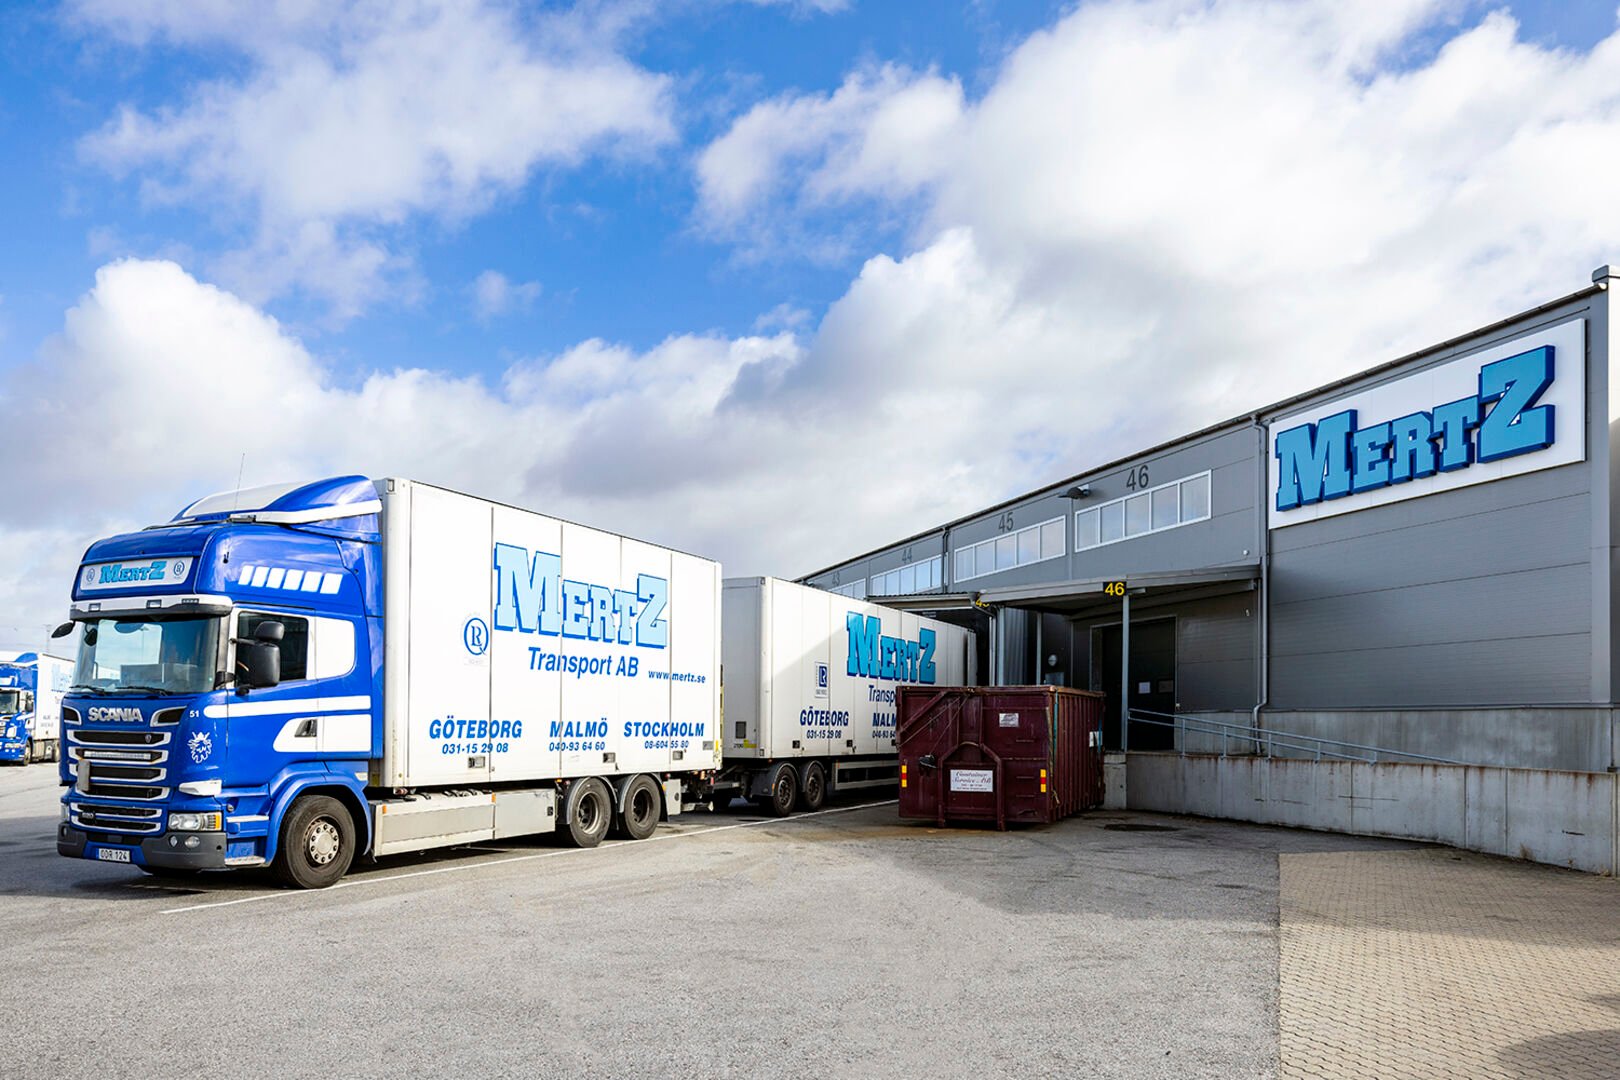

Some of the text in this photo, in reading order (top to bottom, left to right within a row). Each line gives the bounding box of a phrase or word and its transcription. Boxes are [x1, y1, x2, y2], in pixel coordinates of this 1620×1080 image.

[1125, 465, 1149, 491] 46
[997, 512, 1014, 532] 45
[902, 547, 913, 564] 44
[1104, 582, 1125, 596] 46
[528, 646, 639, 679] Transport AB
[648, 669, 706, 684] www.mertz.se
[868, 685, 896, 707] Transp
[87, 706, 144, 722] SCANIA
[189, 710, 200, 718] 51
[800, 706, 849, 727] GÖTEBORG
[872, 712, 896, 727] MALM
[429, 715, 523, 739] GÖTEBORG
[549, 718, 608, 738] MALMÖ
[623, 721, 705, 738] STOCKHOLM
[442, 742, 509, 754] 031-15 29 08
[549, 741, 606, 751] 040-93 64 60
